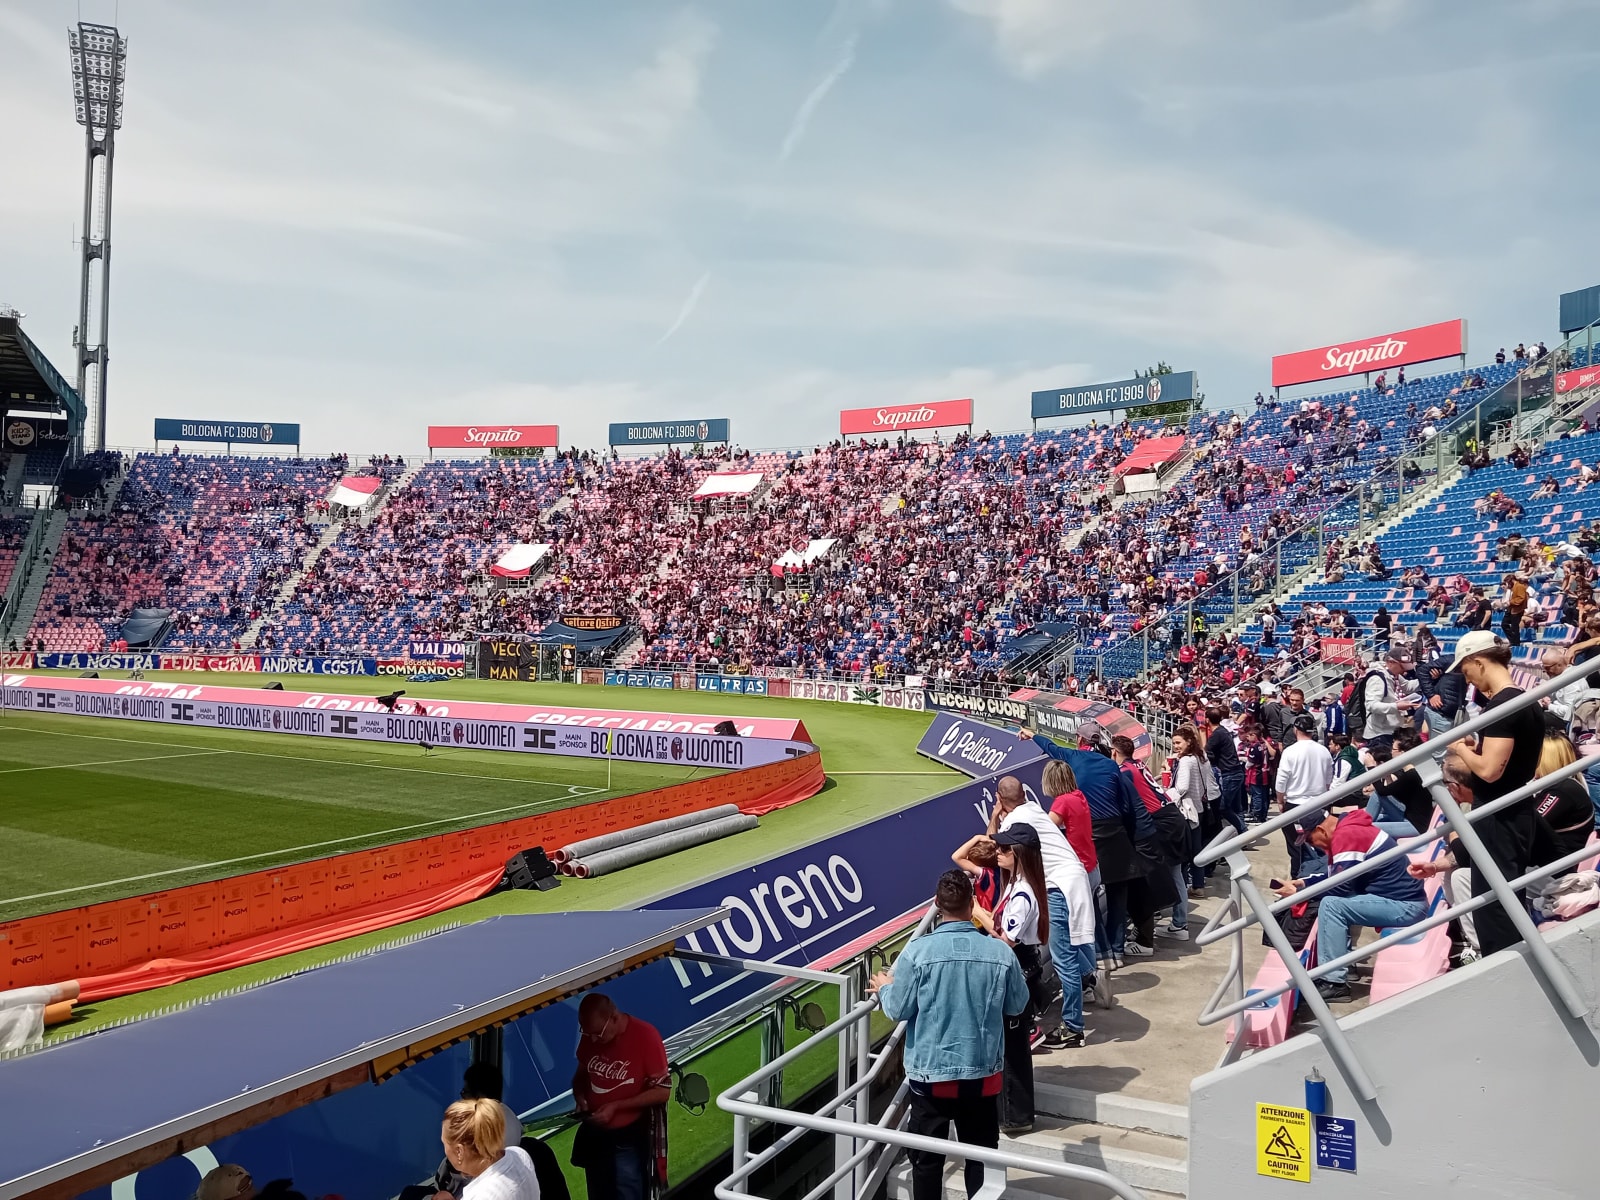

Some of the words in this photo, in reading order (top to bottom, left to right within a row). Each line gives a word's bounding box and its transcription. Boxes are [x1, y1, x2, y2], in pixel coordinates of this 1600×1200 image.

[1321, 337, 1408, 373] Saputo
[1060, 389, 1103, 409] BOLOGNA
[1105, 388, 1117, 404] FC
[1119, 384, 1144, 402] 1909
[872, 406, 937, 430] Saputo
[181, 424, 222, 437] BOLOGNA
[224, 426, 235, 438] FC
[236, 426, 258, 439] 1909
[463, 427, 523, 447] Saputo
[628, 425, 664, 440] BOLOGNA
[664, 426, 675, 439] FC
[675, 425, 695, 438] 1909
[413, 642, 439, 655] MAI
[56, 653, 81, 669] LA
[86, 653, 154, 670] NOSTRA
[160, 655, 206, 672] FEDE
[207, 656, 257, 672] CURVA
[262, 657, 314, 674] ANDREA
[322, 658, 366, 676] COSTA
[377, 665, 464, 677] COMMANDOS
[699, 678, 764, 693] ULTRAS
[4, 689, 33, 708] WOMEN
[75, 694, 113, 715] BOLOGNA
[130, 699, 164, 719] WOMEN
[929, 692, 986, 712] VECCHIO
[987, 698, 1028, 720] CUORE
[217, 705, 261, 728] BOLOGNA
[263, 709, 271, 722] FC
[283, 710, 324, 733] WOMEN
[360, 726, 384, 734] SPONSOR
[387, 718, 440, 742] BOLOGNA
[441, 721, 451, 736] FC
[466, 722, 516, 748] WOMEN
[565, 733, 581, 741] MAIN
[559, 740, 588, 749] SPONSOR
[590, 731, 654, 759] BOLOGNA
[656, 736, 668, 752] FC
[685, 738, 743, 765] WOMEN
[951, 731, 1013, 771] Pelliconi
[587, 1055, 632, 1080] Coca-Cola
[1260, 1106, 1305, 1120] ATTENZIONE
[1267, 1159, 1299, 1172] CAUTION
